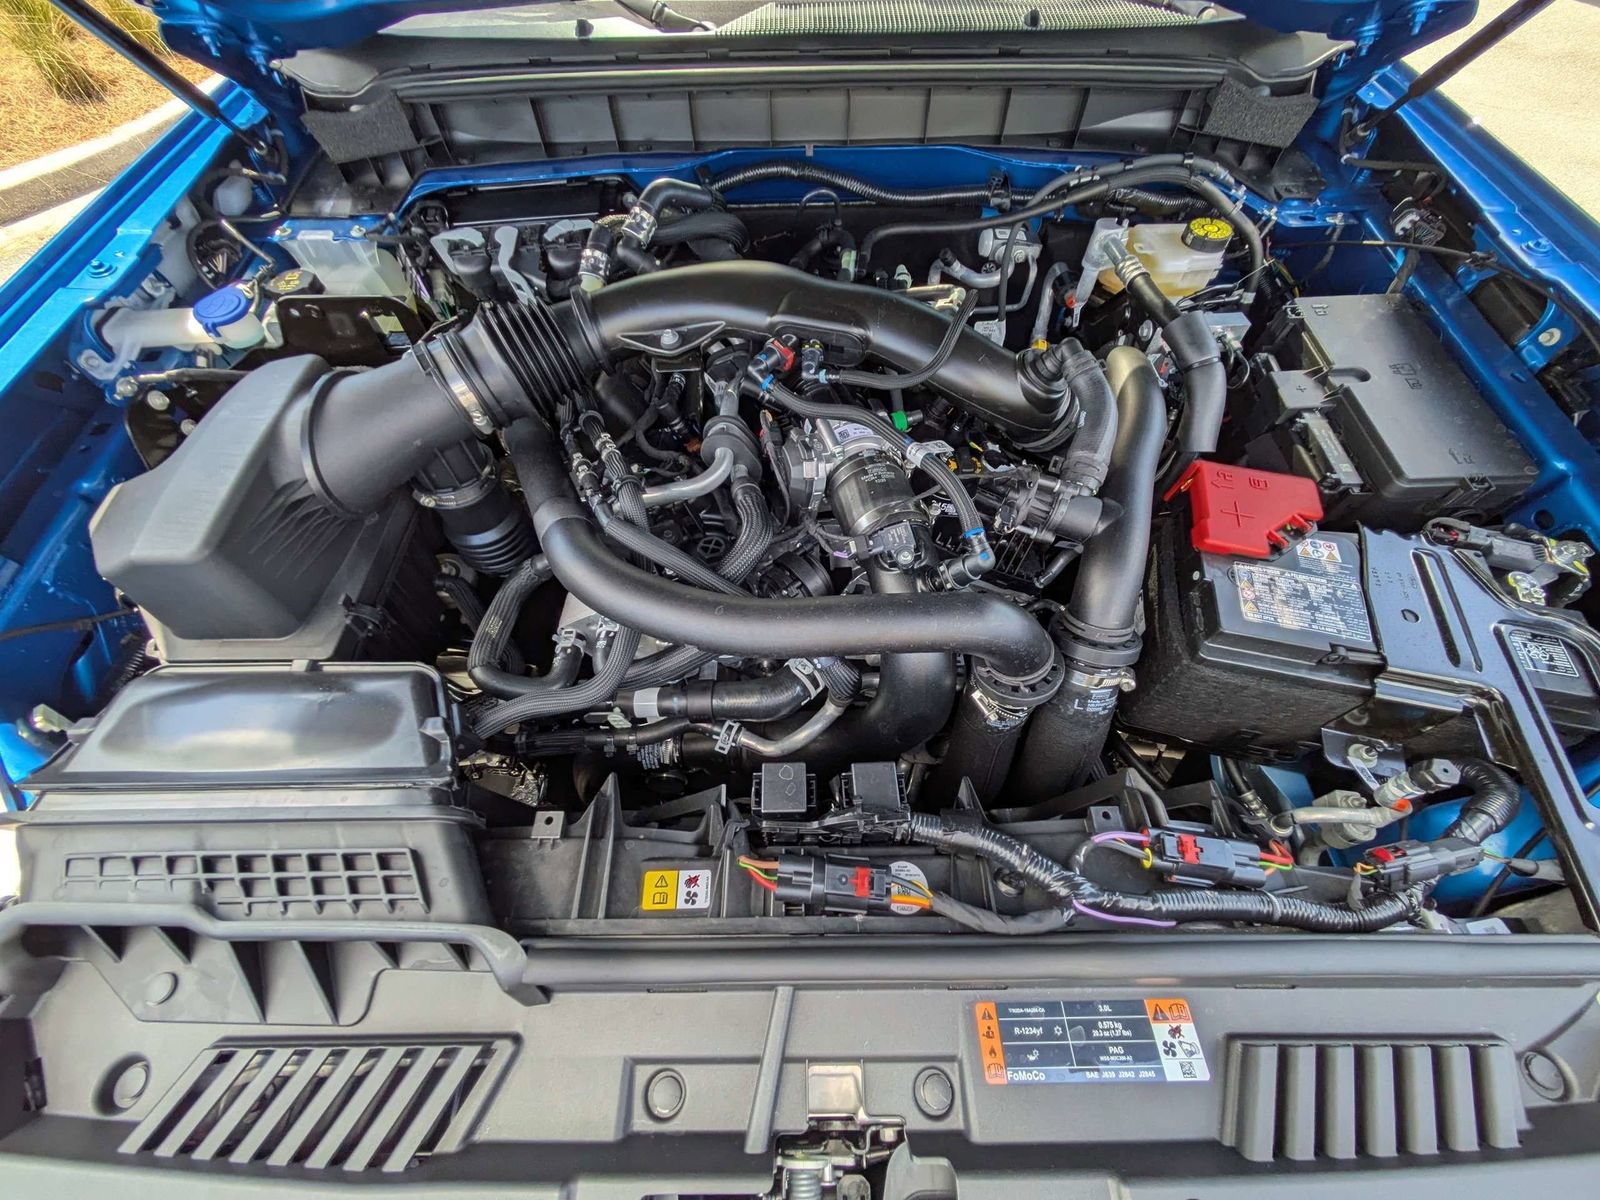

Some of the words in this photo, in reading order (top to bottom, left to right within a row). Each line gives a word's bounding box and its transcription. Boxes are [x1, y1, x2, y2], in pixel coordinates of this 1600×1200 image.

[1074, 699, 1083, 710] L
[1098, 1004, 1112, 1012] 3.0L
[1098, 1021, 1114, 1029] 0.575
[1114, 1021, 1122, 1030] kg
[1014, 1027, 1043, 1038] R-1234yf
[1108, 1046, 1124, 1054] PAG
[1007, 1070, 1046, 1081] FoMoCo
[1085, 1071, 1100, 1079] SAE
